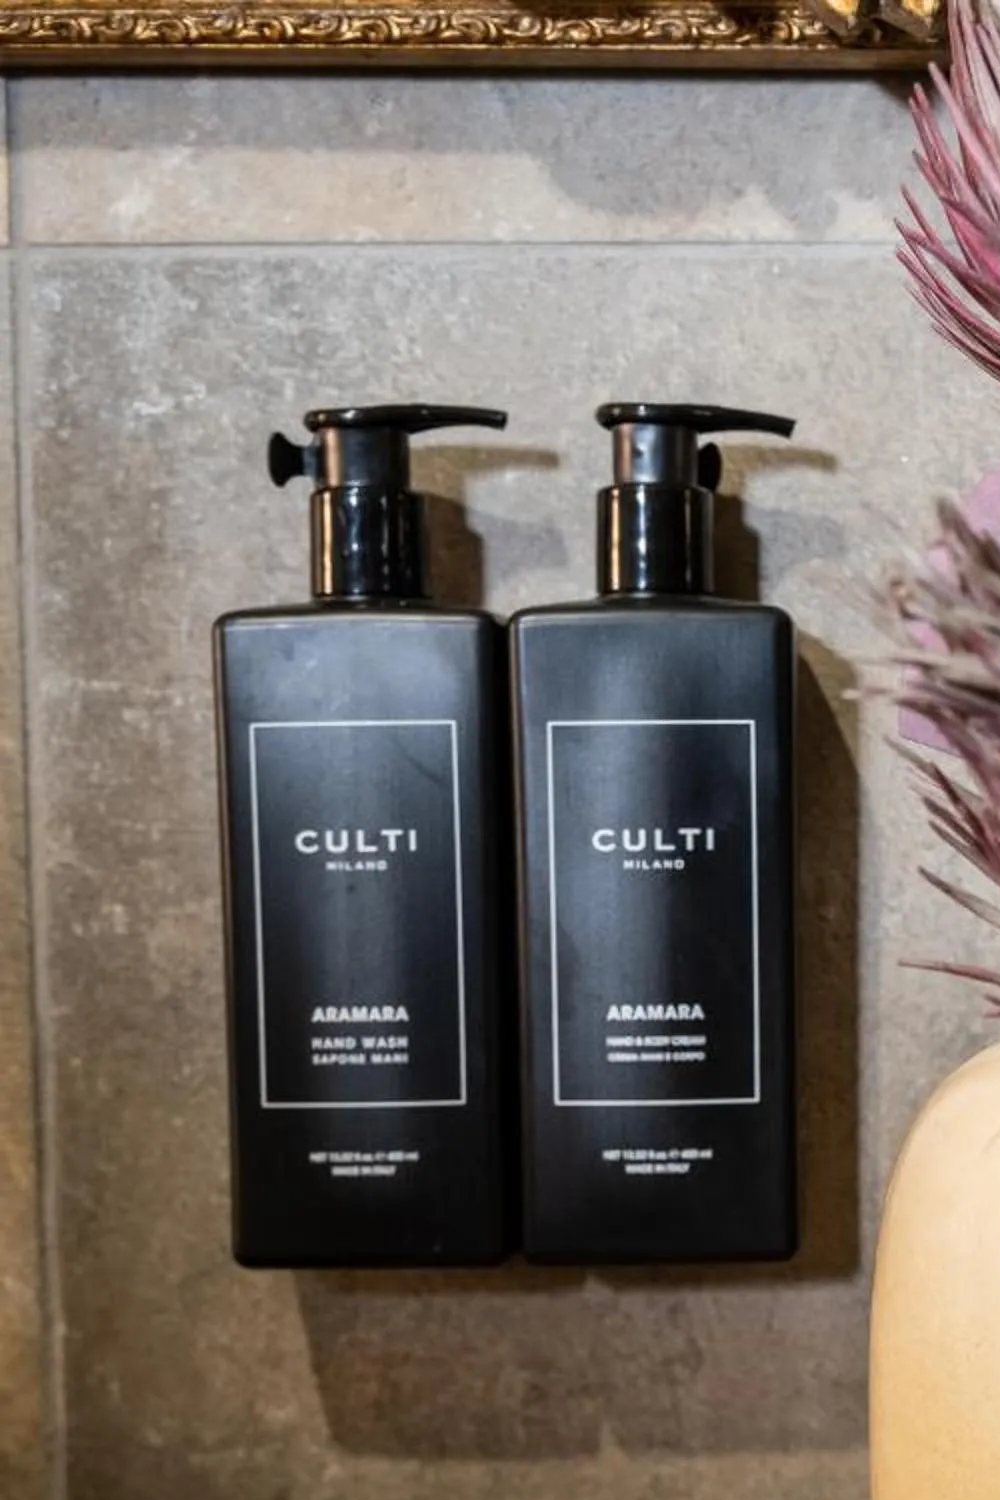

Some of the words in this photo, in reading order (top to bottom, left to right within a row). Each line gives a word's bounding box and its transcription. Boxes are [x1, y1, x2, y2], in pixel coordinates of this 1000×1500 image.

[295, 829, 417, 854] CULTI
[591, 828, 715, 853] CULTI
[325, 860, 388, 872] MILANO
[623, 859, 685, 871] MILANO
[311, 1005, 409, 1023] ARAMARA
[607, 1003, 705, 1021] ARAMARA
